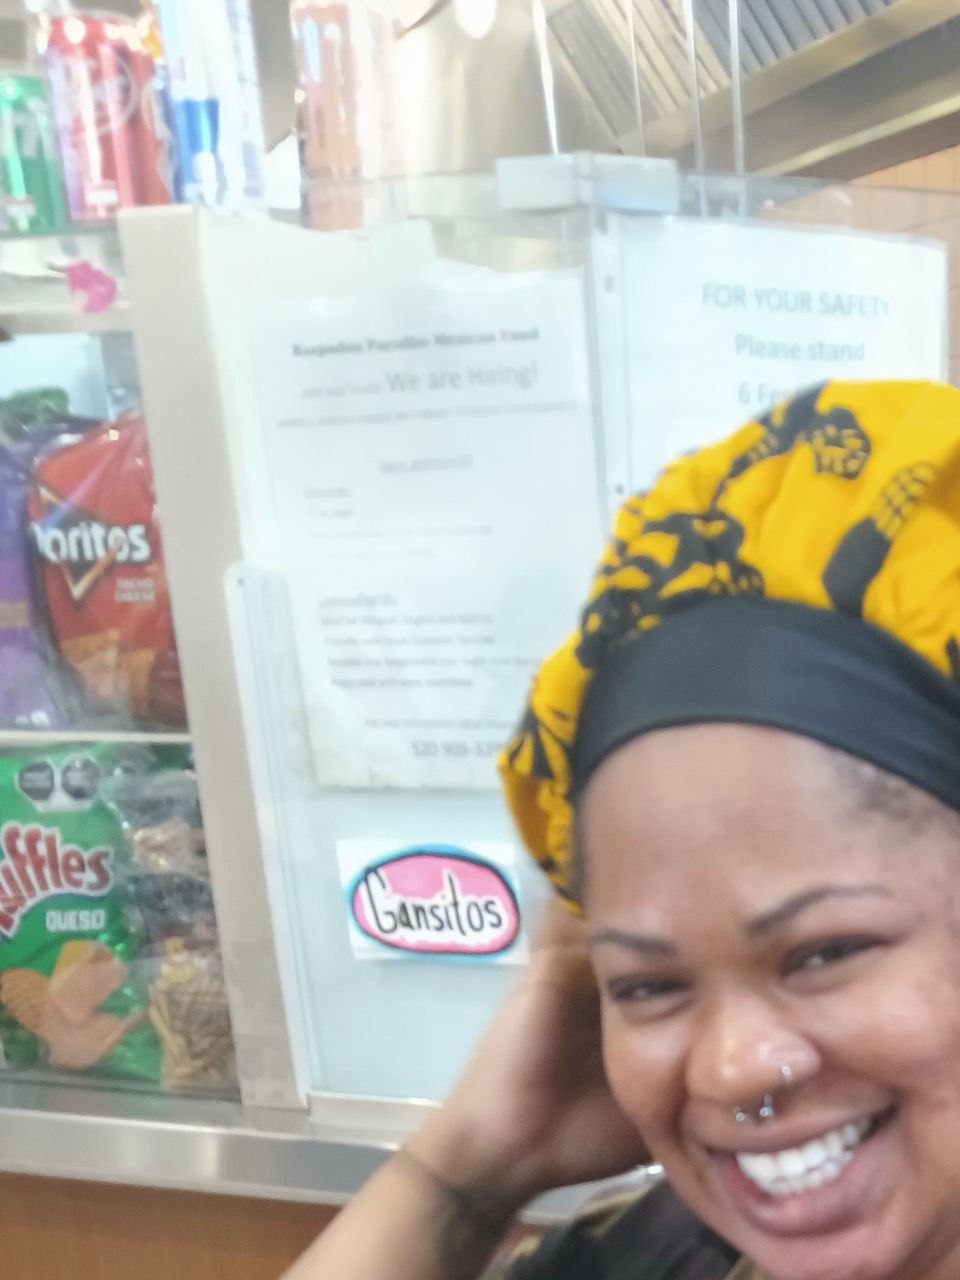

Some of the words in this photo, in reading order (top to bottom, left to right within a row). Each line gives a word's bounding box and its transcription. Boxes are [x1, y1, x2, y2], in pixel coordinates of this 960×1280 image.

[753, 287, 813, 313] YOUR
[734, 332, 801, 361] Please
[807, 341, 865, 362] stand
[385, 368, 422, 393] We
[428, 370, 461, 391] are
[736, 379, 752, 406] 6
[0, 824, 112, 935] uffles
[363, 866, 503, 937] Gansitos
[46, 908, 106, 932] QUESO
